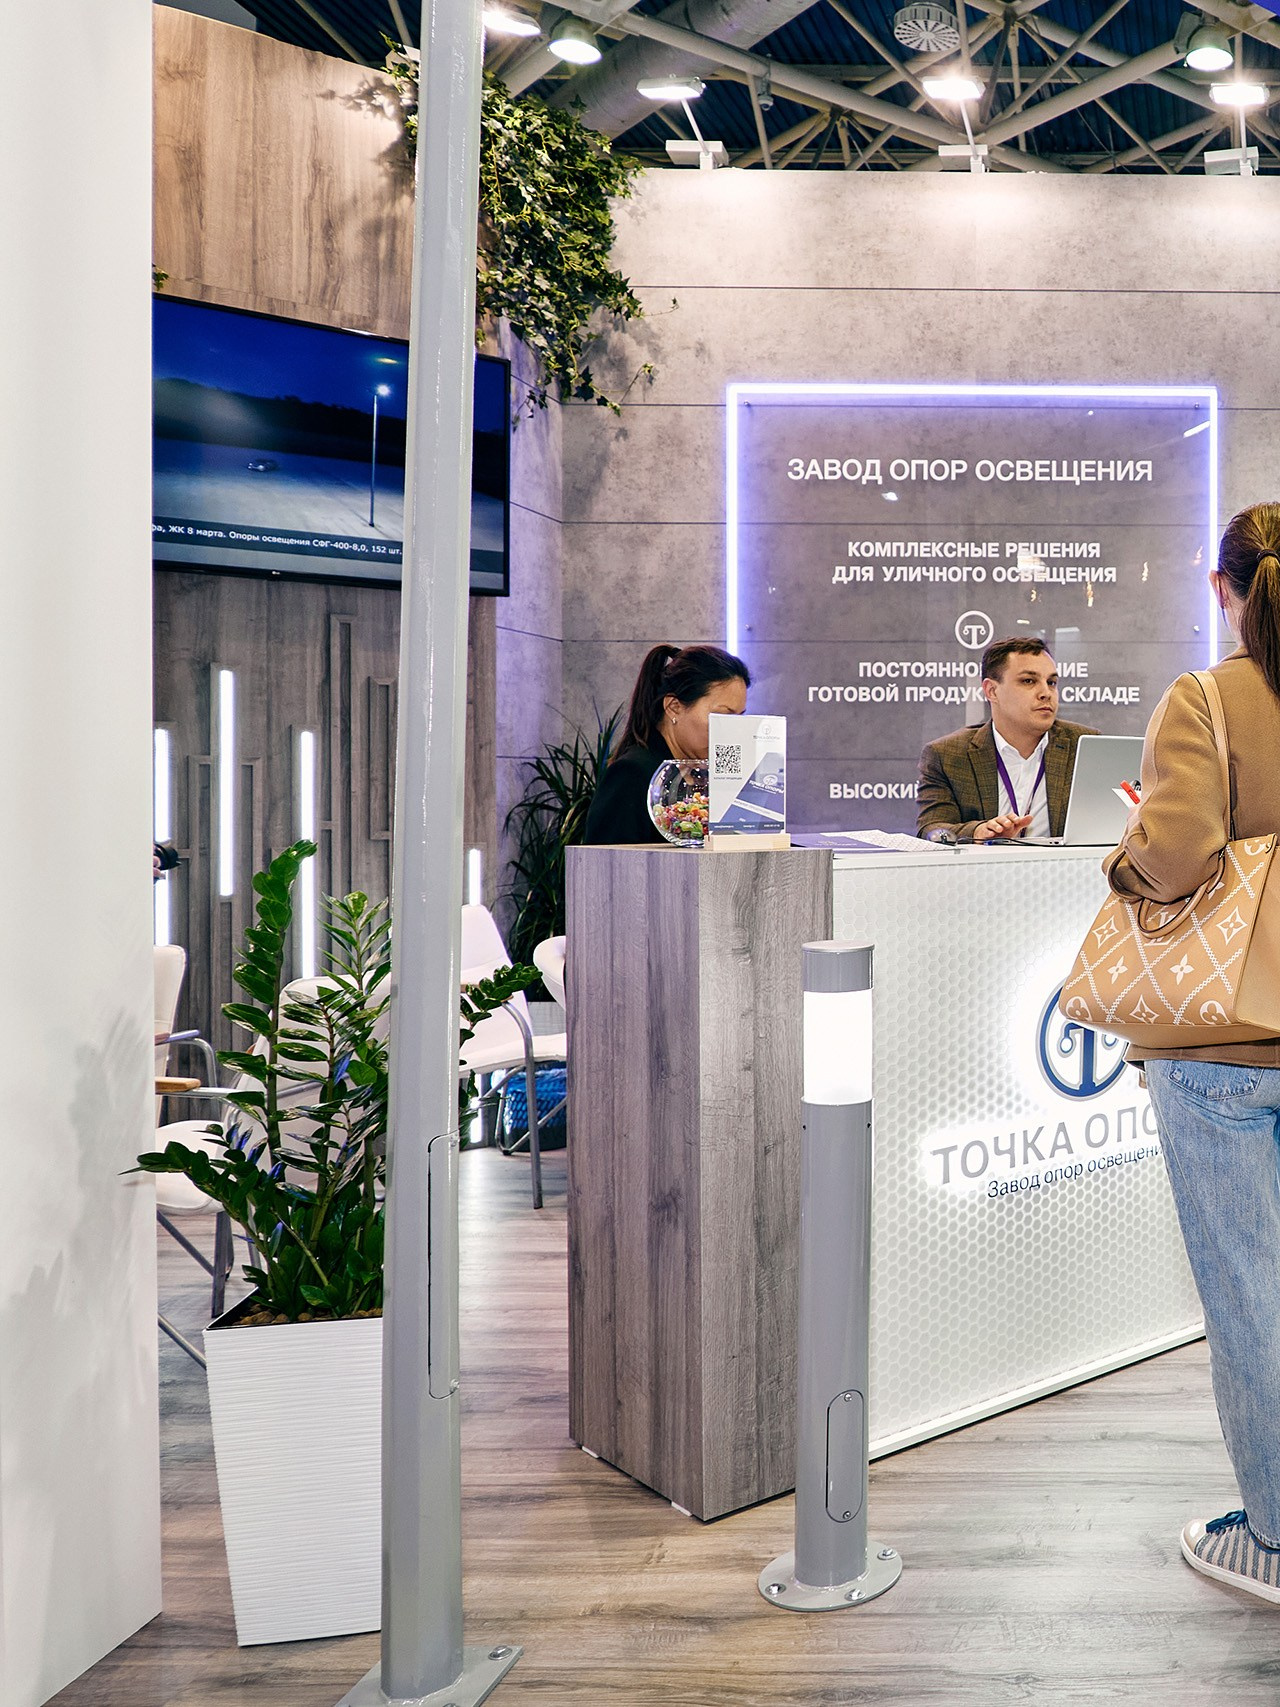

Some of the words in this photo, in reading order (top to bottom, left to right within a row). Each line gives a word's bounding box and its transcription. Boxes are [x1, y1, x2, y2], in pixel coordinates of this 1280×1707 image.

[787, 458, 882, 485] ЗАВОД
[890, 458, 968, 482] ОПОР
[975, 459, 1153, 486] ОСВЕЩЕНИЯ
[168, 524, 185, 534] ЖК
[187, 526, 194, 535] 8
[196, 528, 226, 539] марта.
[229, 531, 260, 542] Опоры
[262, 535, 310, 547] освещения
[371, 545, 387, 554] 152
[847, 541, 1000, 559] КОМПЛЕКСНЫЕ
[1005, 541, 1101, 560] РЕШЕНИЯ
[832, 565, 874, 584] ДЛЯ
[882, 565, 987, 584] УЛИЧНОГО
[992, 565, 1117, 585] ОСВЕЩЕНИЯ
[858, 661, 983, 678] ПОСТОЯННО
[808, 682, 900, 703] ГОТОВОЙ
[905, 685, 988, 705] ПРОДУК
[1061, 686, 1140, 705] СКЛАДЕ
[930, 1120, 1075, 1185] ТОЧКА
[1084, 1103, 1158, 1149] ОПО
[987, 1173, 1041, 1199] Завод
[1044, 1162, 1085, 1185] опор
[1087, 1145, 1163, 1174] освещени
